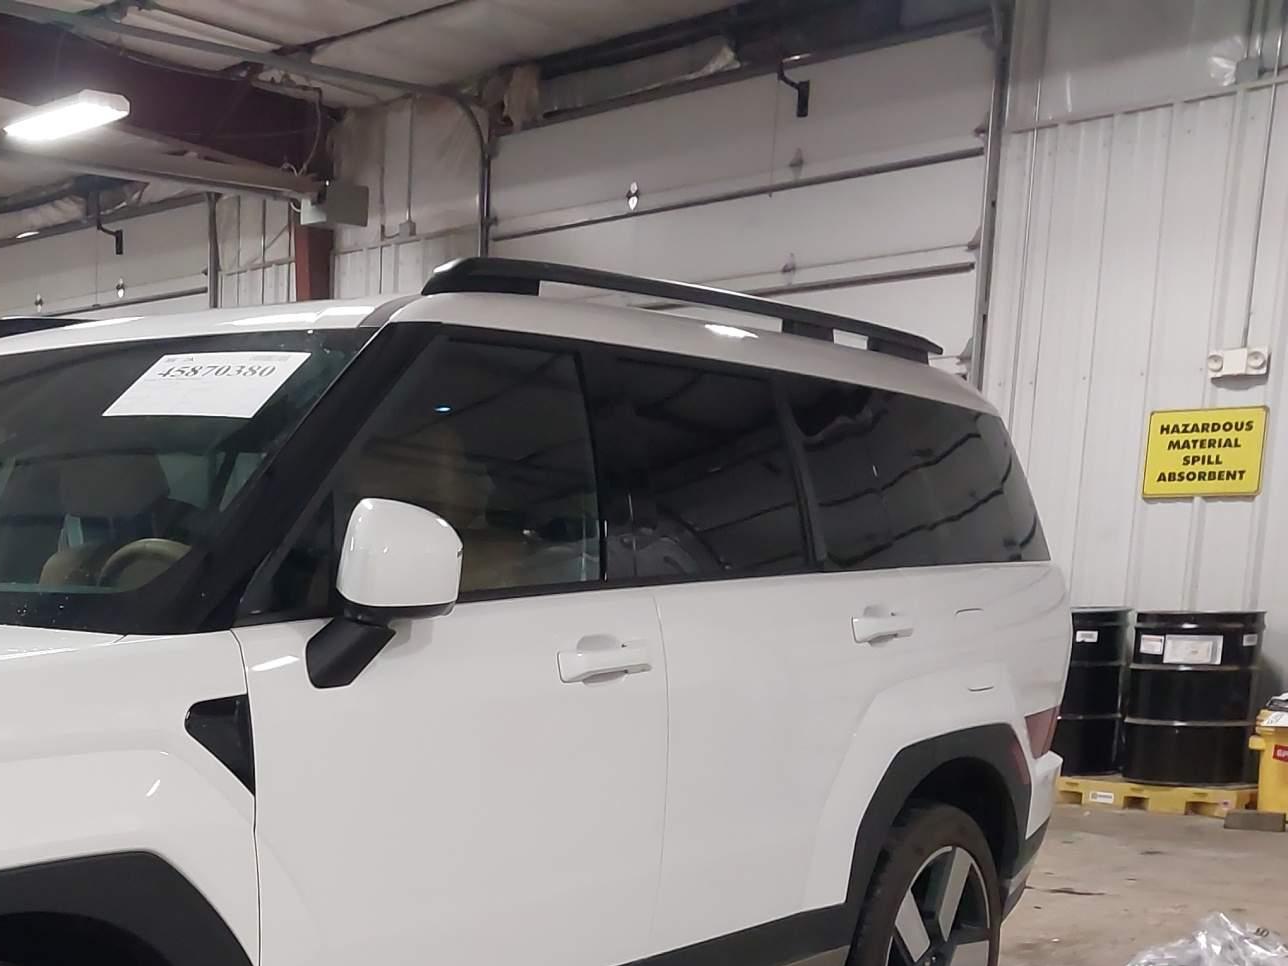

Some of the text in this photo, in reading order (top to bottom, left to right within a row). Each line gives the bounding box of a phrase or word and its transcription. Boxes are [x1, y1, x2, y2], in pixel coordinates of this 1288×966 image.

[158, 365, 276, 378] 45870380
[1159, 420, 1254, 435] HAZARDOUS
[1167, 437, 1241, 451] MATERIAL
[1182, 454, 1223, 466] SPILL
[1156, 470, 1247, 482] ABSORBENT
